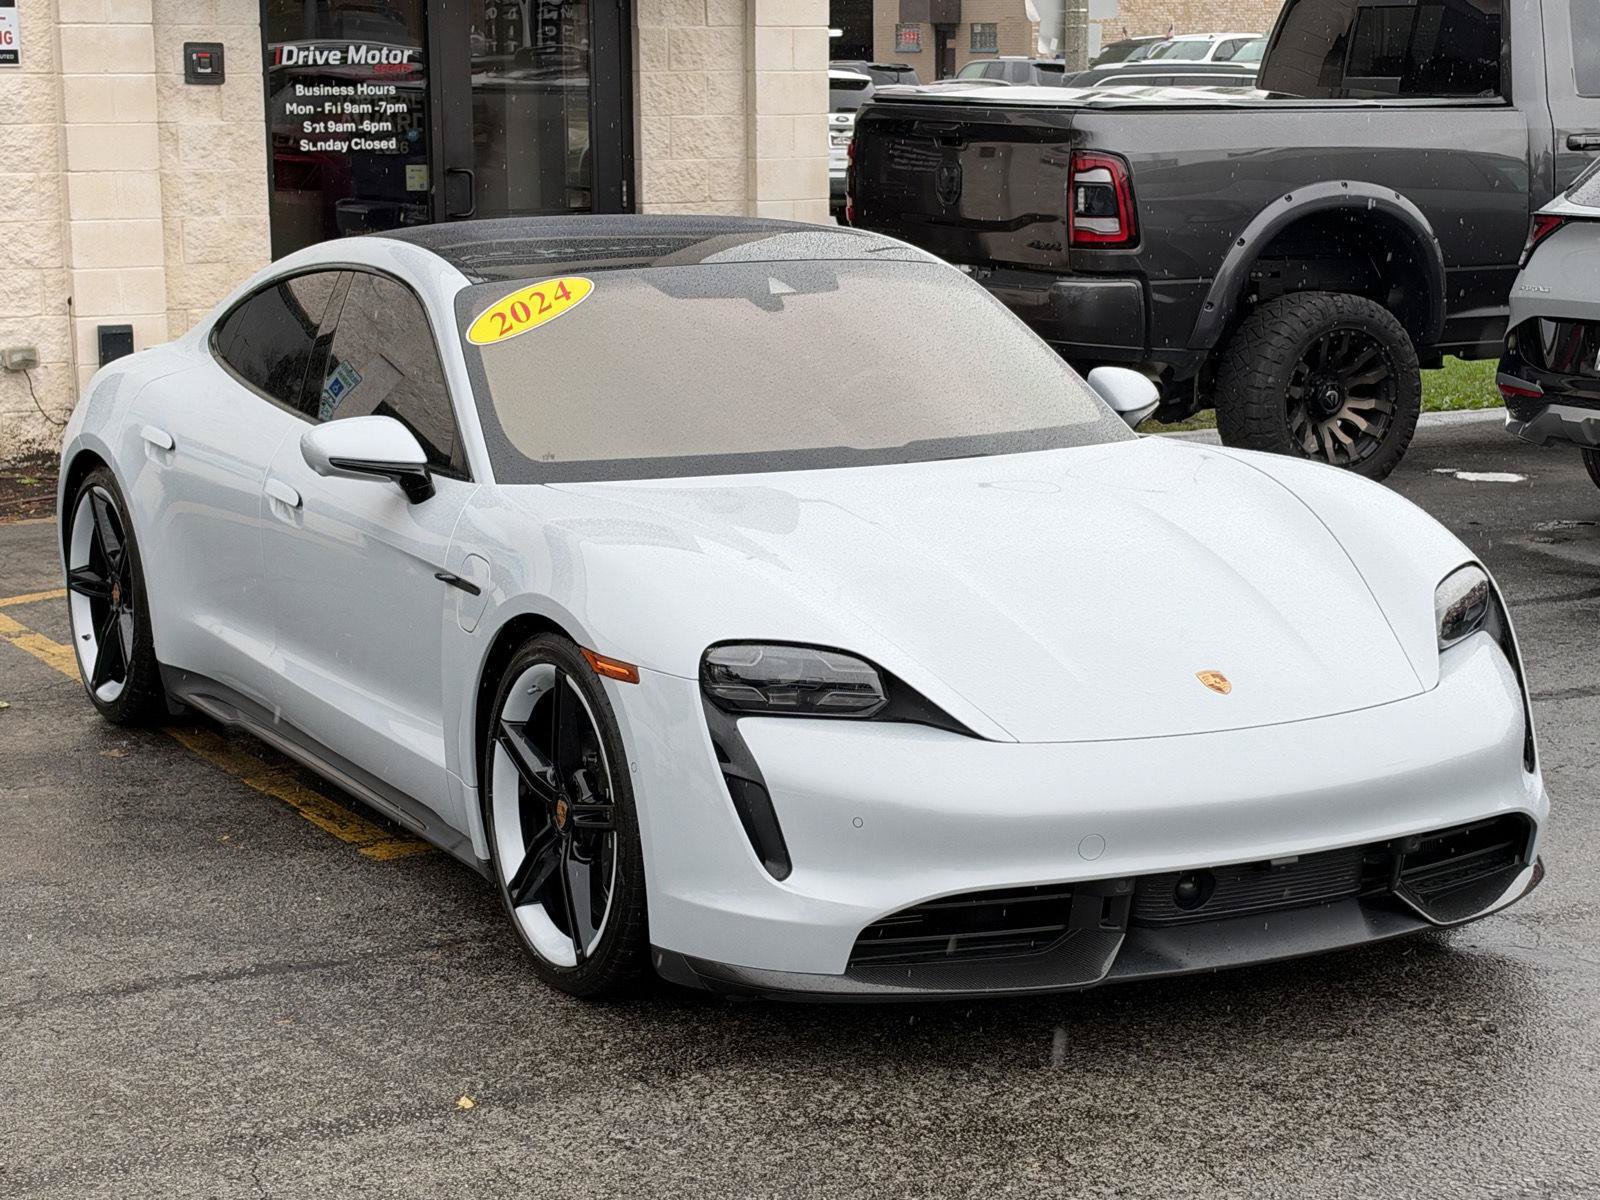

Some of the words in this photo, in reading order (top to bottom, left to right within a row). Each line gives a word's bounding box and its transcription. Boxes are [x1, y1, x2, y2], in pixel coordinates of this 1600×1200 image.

[347, 45, 413, 65] Motor
[295, 84, 354, 96] Business
[357, 83, 396, 95] Hours
[285, 102, 314, 114] Mon
[343, 102, 372, 113] 9am
[327, 121, 356, 132] 9am
[350, 138, 396, 150] Closed
[490, 280, 572, 336] 2024
